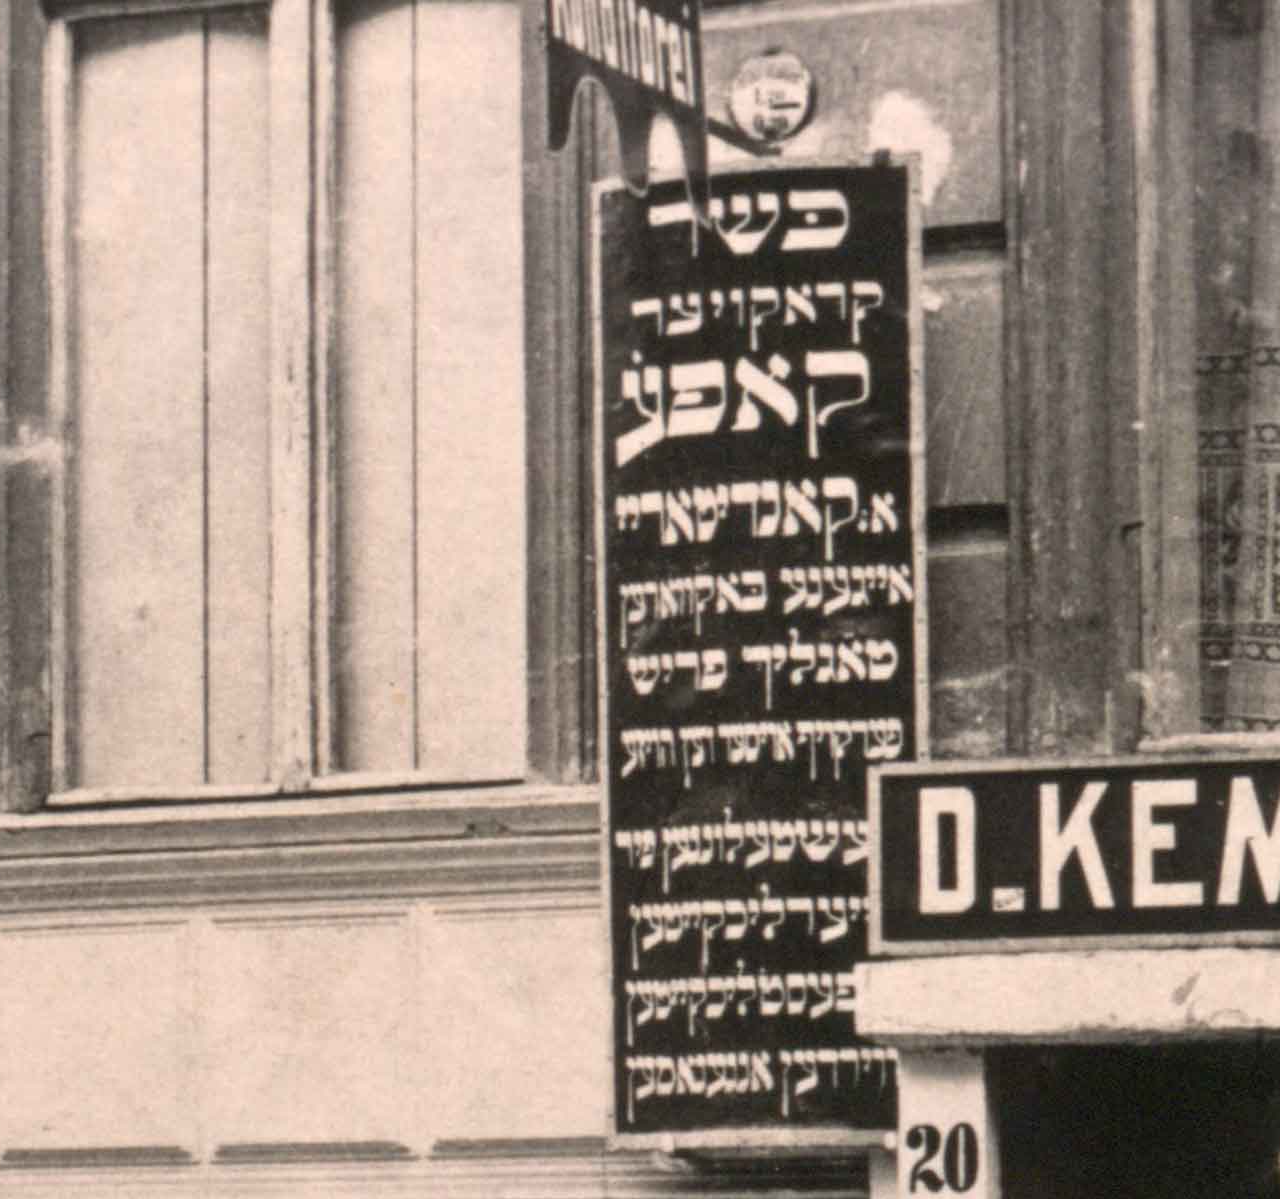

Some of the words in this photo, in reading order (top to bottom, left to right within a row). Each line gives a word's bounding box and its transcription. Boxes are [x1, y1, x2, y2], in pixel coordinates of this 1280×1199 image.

[632, 282, 882, 354] קראקויער
[662, 803, 867, 896] עשטעלונגען
[907, 1124, 978, 1192] 20
